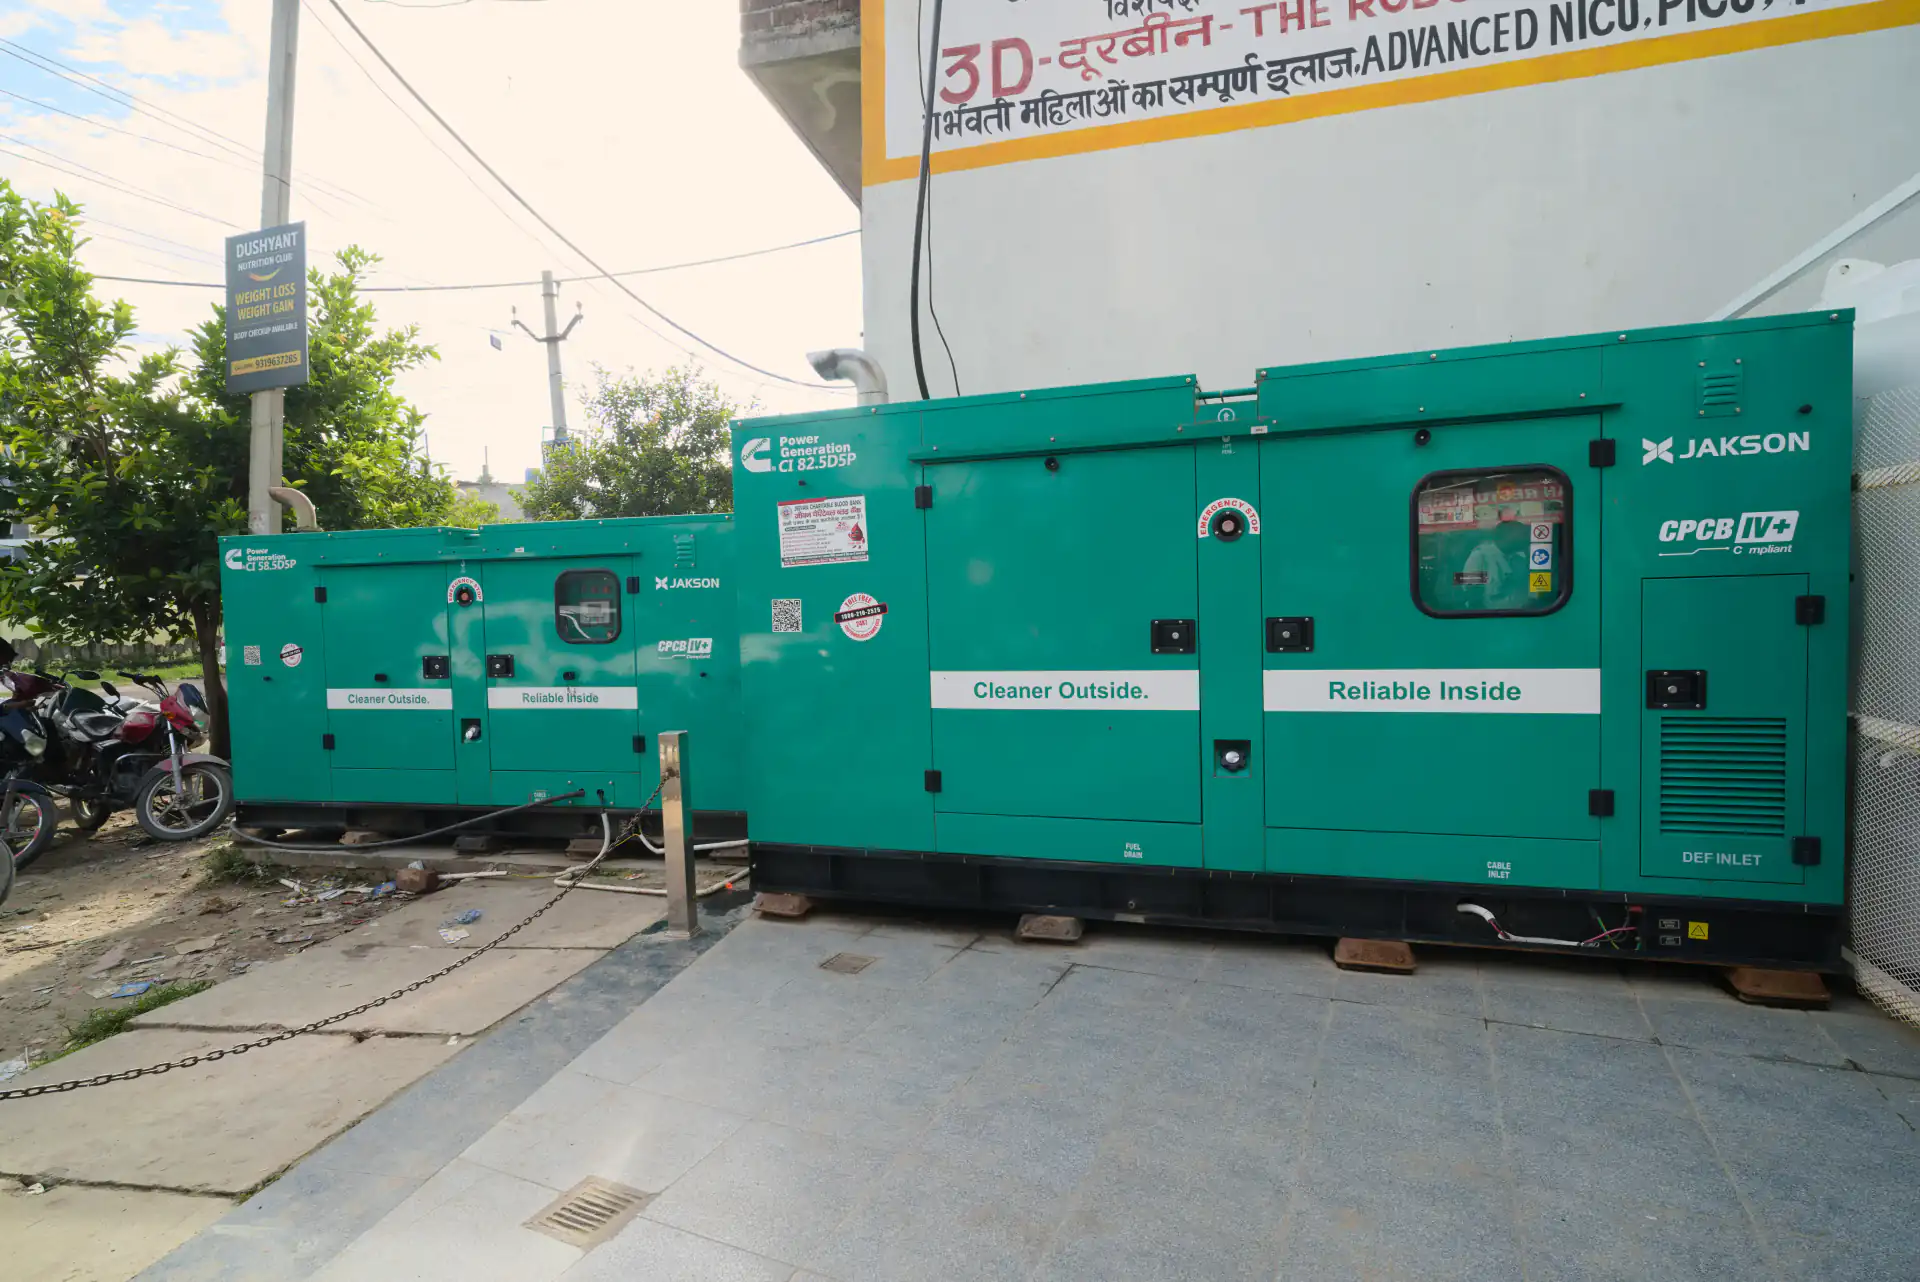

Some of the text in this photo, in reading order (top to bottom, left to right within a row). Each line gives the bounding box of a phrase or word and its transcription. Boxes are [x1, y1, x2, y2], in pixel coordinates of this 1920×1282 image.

[1240, 0, 1331, 38] THE
[1020, 79, 1130, 130] महिलाओं
[1132, 80, 1167, 111] का
[1168, 52, 1265, 105] सम्पूर्ण
[236, 231, 298, 258] DUSHYANT
[238, 252, 294, 272] NUTRITION CLUB
[235, 282, 295, 306] WEIGHT LOSS
[238, 299, 295, 320] WEIGHT GAIN
[234, 321, 299, 341] BODY CHECKUP AVAILABLE
[779, 435, 819, 447] Power
[780, 443, 851, 458] Generation
[1679, 431, 1810, 459] JAKSON
[778, 453, 857, 473] CI 82.5D5P
[1200, 500, 1258, 535] EMERGENCY STOP
[1658, 518, 1735, 542] CPCB
[1733, 544, 1792, 556] Cmpliant
[258, 559, 297, 571] 58.5D5P
[669, 578, 720, 589] JAKSON
[658, 640, 687, 652] CPCB
[347, 694, 430, 704] Cleaner Outside.
[522, 692, 599, 704] Reliable Inside
[973, 681, 1149, 700] Cleaner Outside.
[1328, 680, 1522, 701] Reliable Inside
[1487, 861, 1512, 870] CABLE
[1682, 851, 1762, 866] DEF INLET
[1488, 870, 1511, 879] INLET
